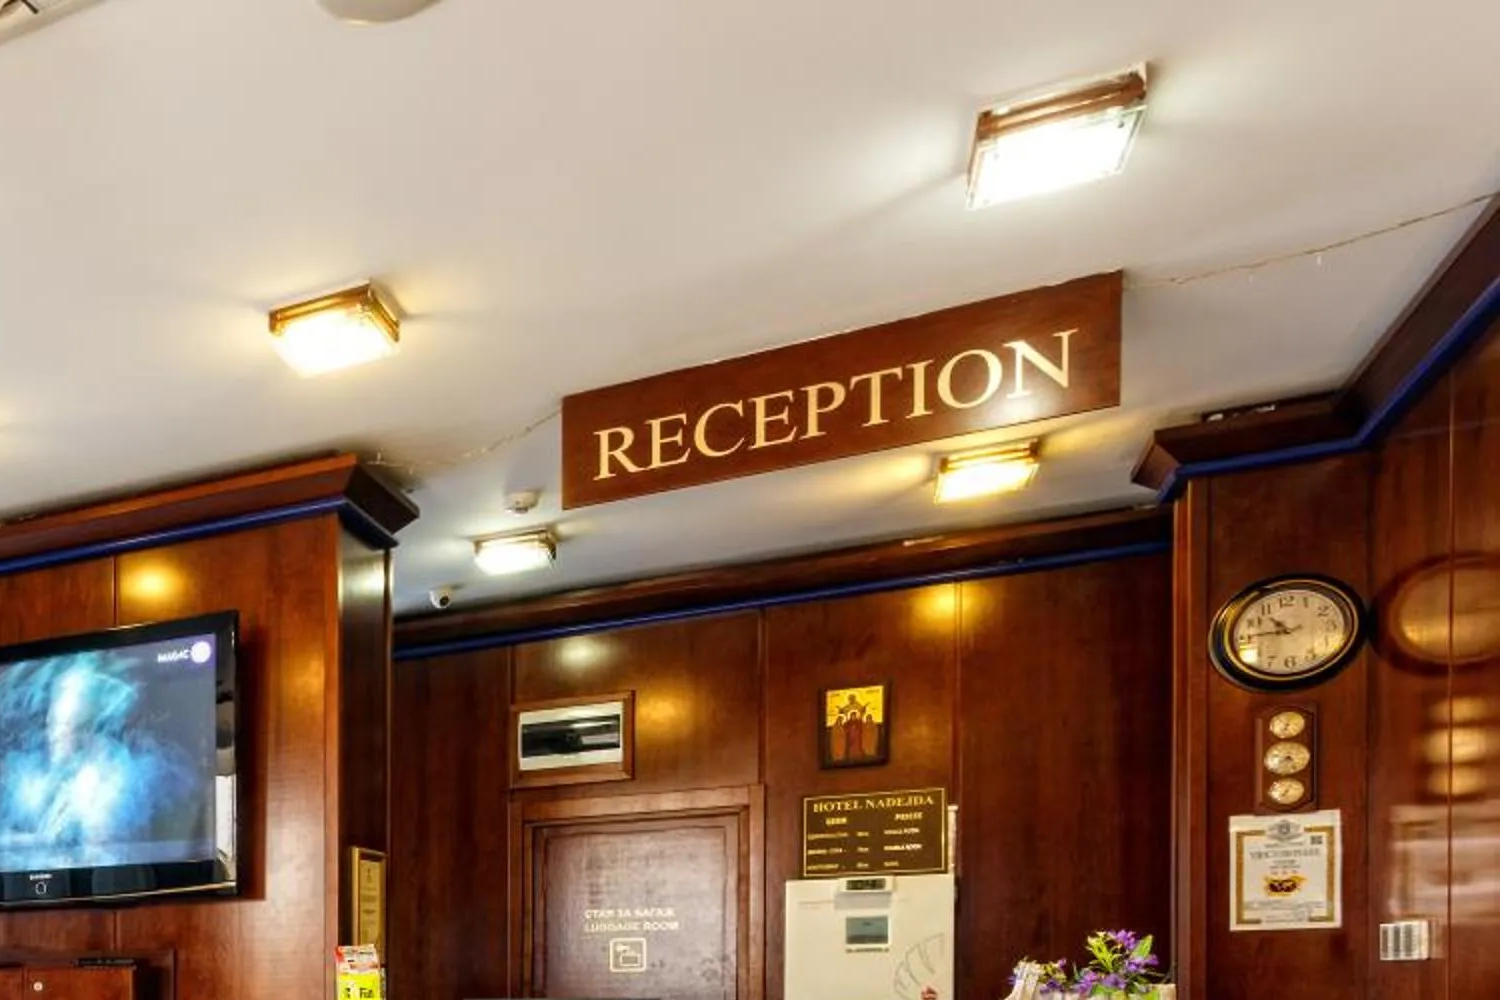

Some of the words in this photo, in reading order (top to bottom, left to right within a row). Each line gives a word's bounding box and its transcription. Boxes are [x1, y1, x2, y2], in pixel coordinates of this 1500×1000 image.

[592, 328, 1078, 481] RECEPTION
[813, 800, 863, 813] HOTEL
[865, 795, 934, 809] NADEJDA
[643, 920, 679, 931] ROOM
